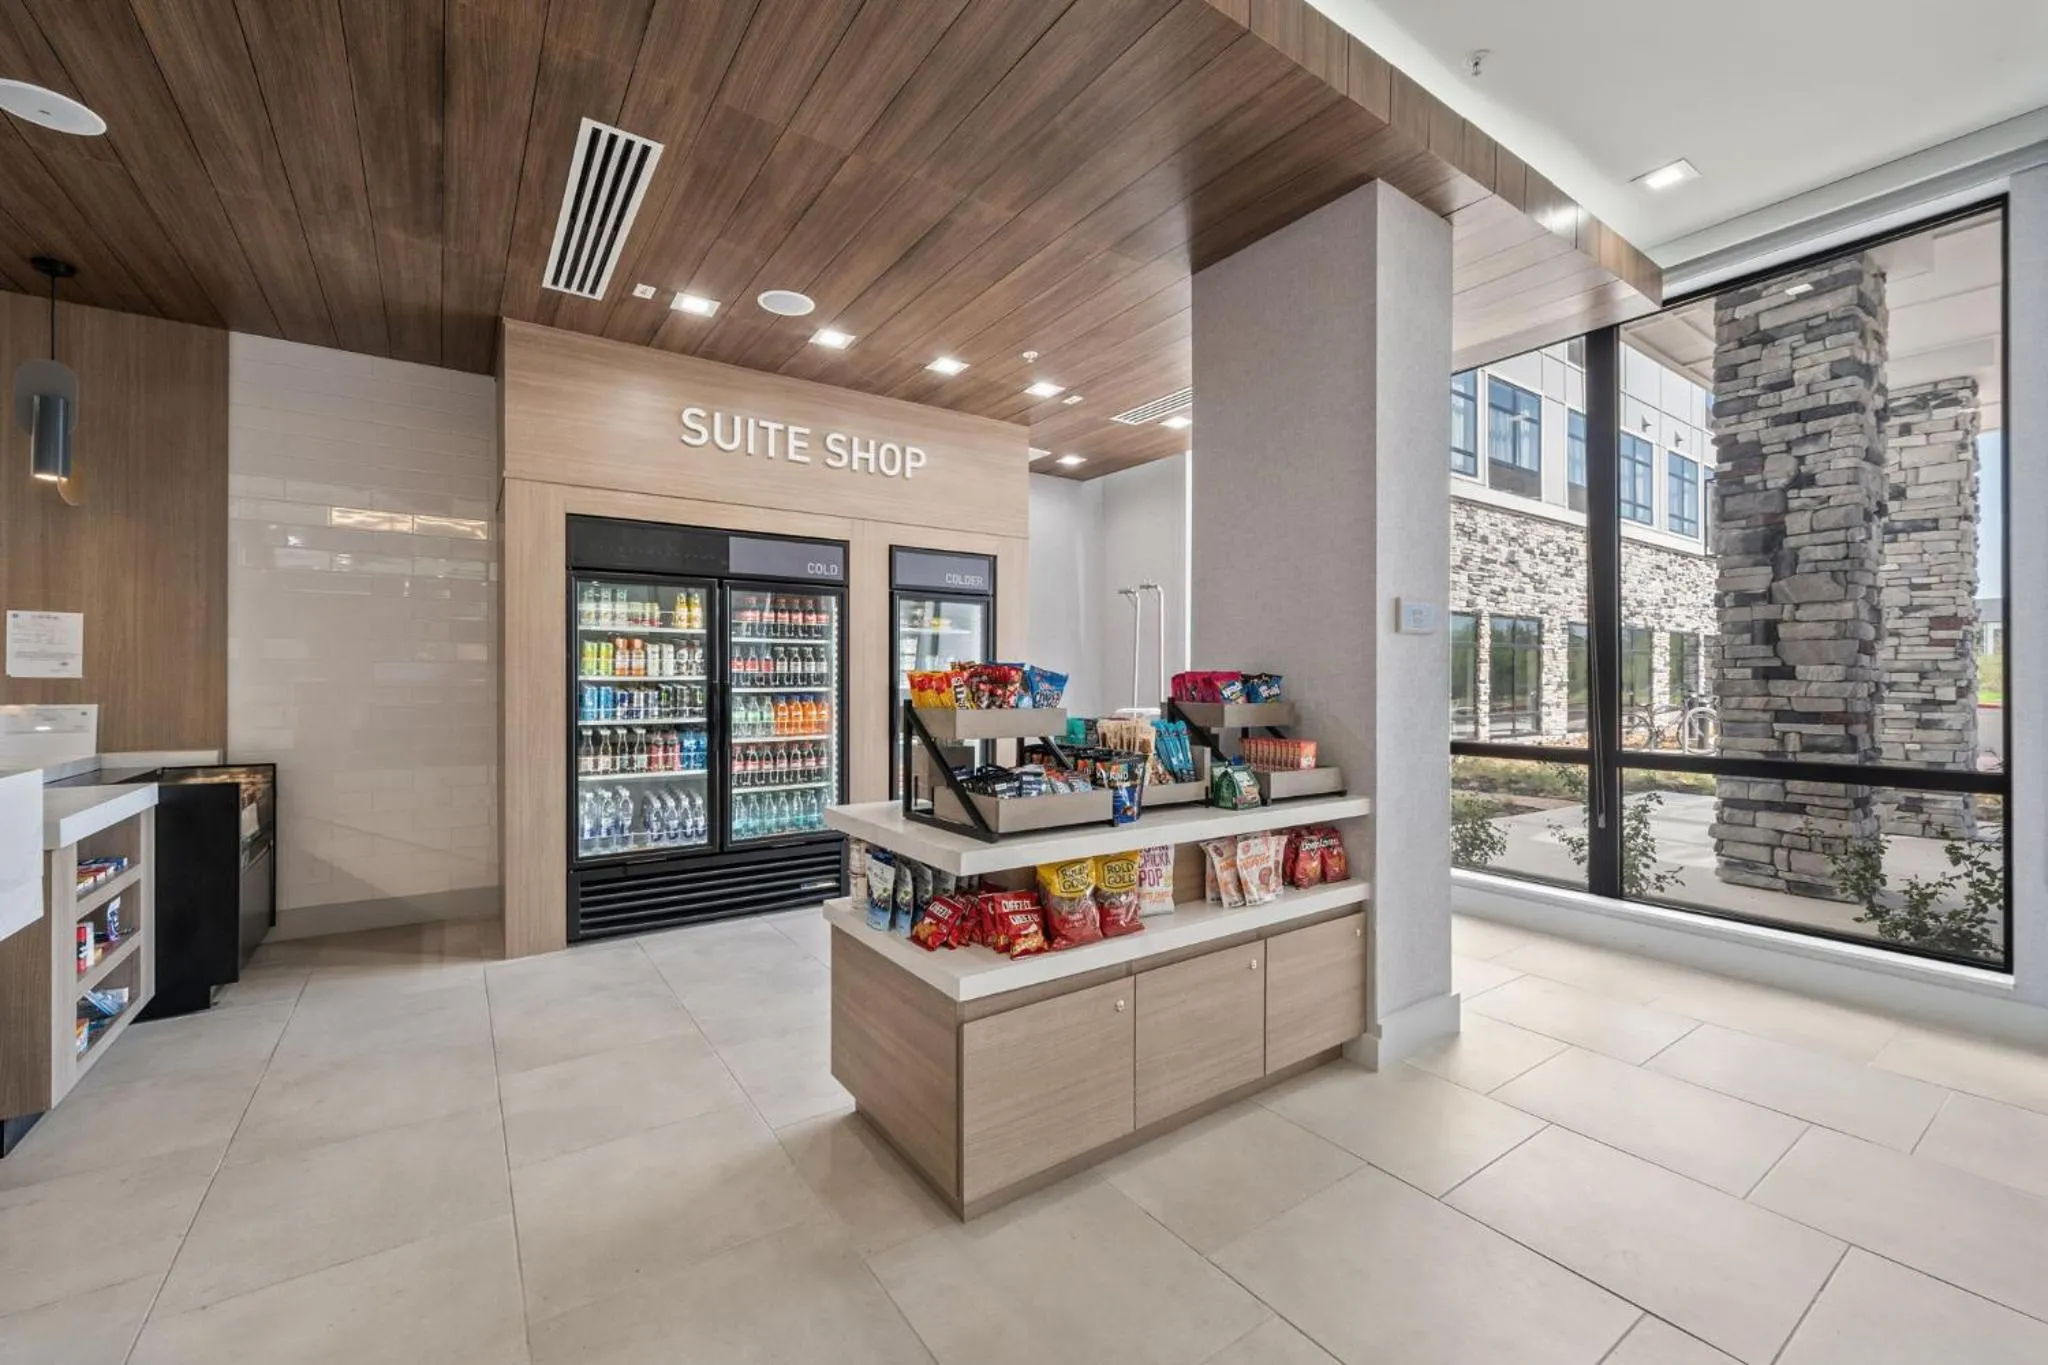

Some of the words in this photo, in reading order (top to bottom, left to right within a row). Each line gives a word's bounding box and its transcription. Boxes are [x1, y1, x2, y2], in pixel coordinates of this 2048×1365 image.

[680, 406, 811, 463] SUITE
[824, 432, 927, 479] SHOP
[807, 562, 839, 576] COLD
[945, 572, 985, 588] COLDER
[1106, 861, 1134, 874] ROLD
[1138, 868, 1163, 887] POP
